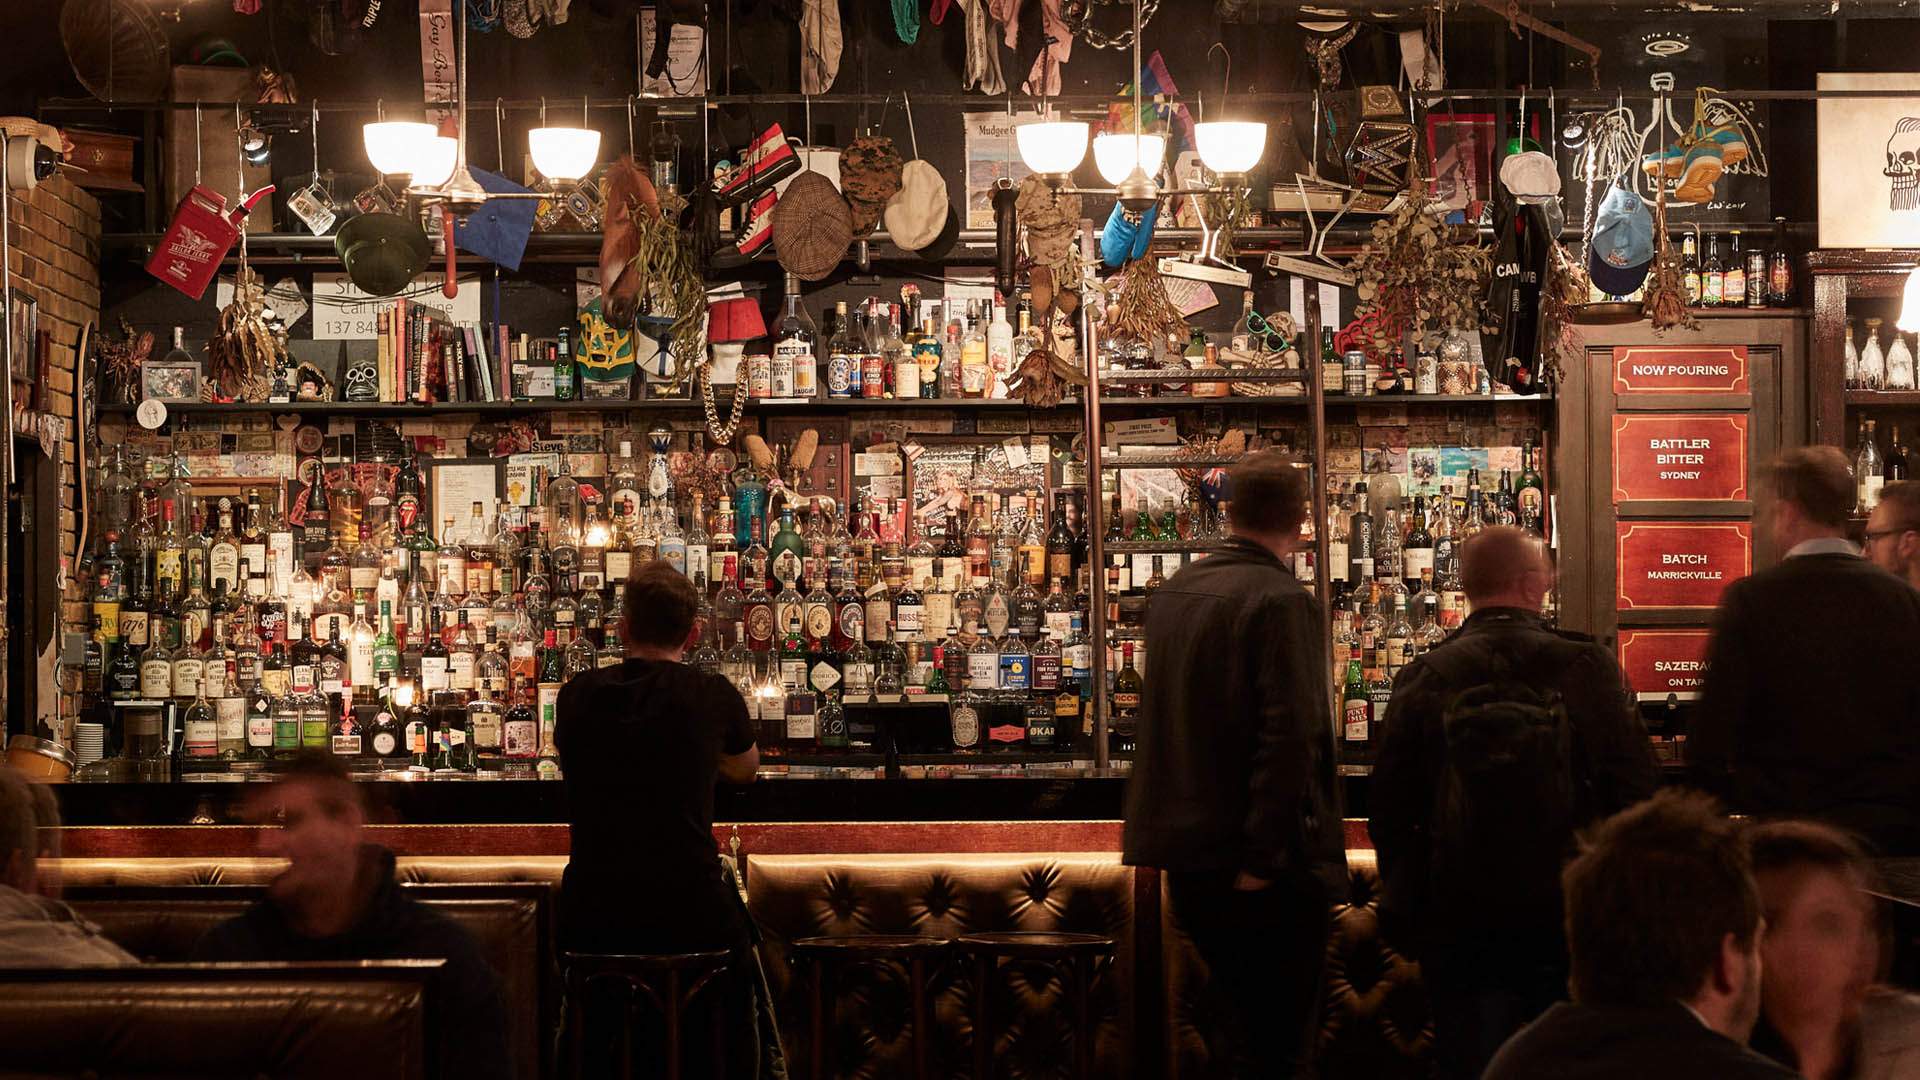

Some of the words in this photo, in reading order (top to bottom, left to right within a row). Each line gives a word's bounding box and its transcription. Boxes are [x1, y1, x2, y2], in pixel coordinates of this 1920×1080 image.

[429, 14, 446, 46] Gay
[979, 125, 1008, 137] Mudgee
[341, 302, 366, 315] Call
[325, 321, 351, 335] 137
[1633, 365, 1666, 376] NOW
[1668, 365, 1729, 376] POURING
[533, 440, 563, 452] Steve
[1650, 439, 1710, 449] BATTLER
[1657, 454, 1704, 464] BITTER
[1660, 471, 1700, 480] SYDNEY
[1662, 554, 1708, 564] BATCH
[1648, 571, 1722, 580] MARRICKVILLE
[1668, 678, 1684, 687] ON
